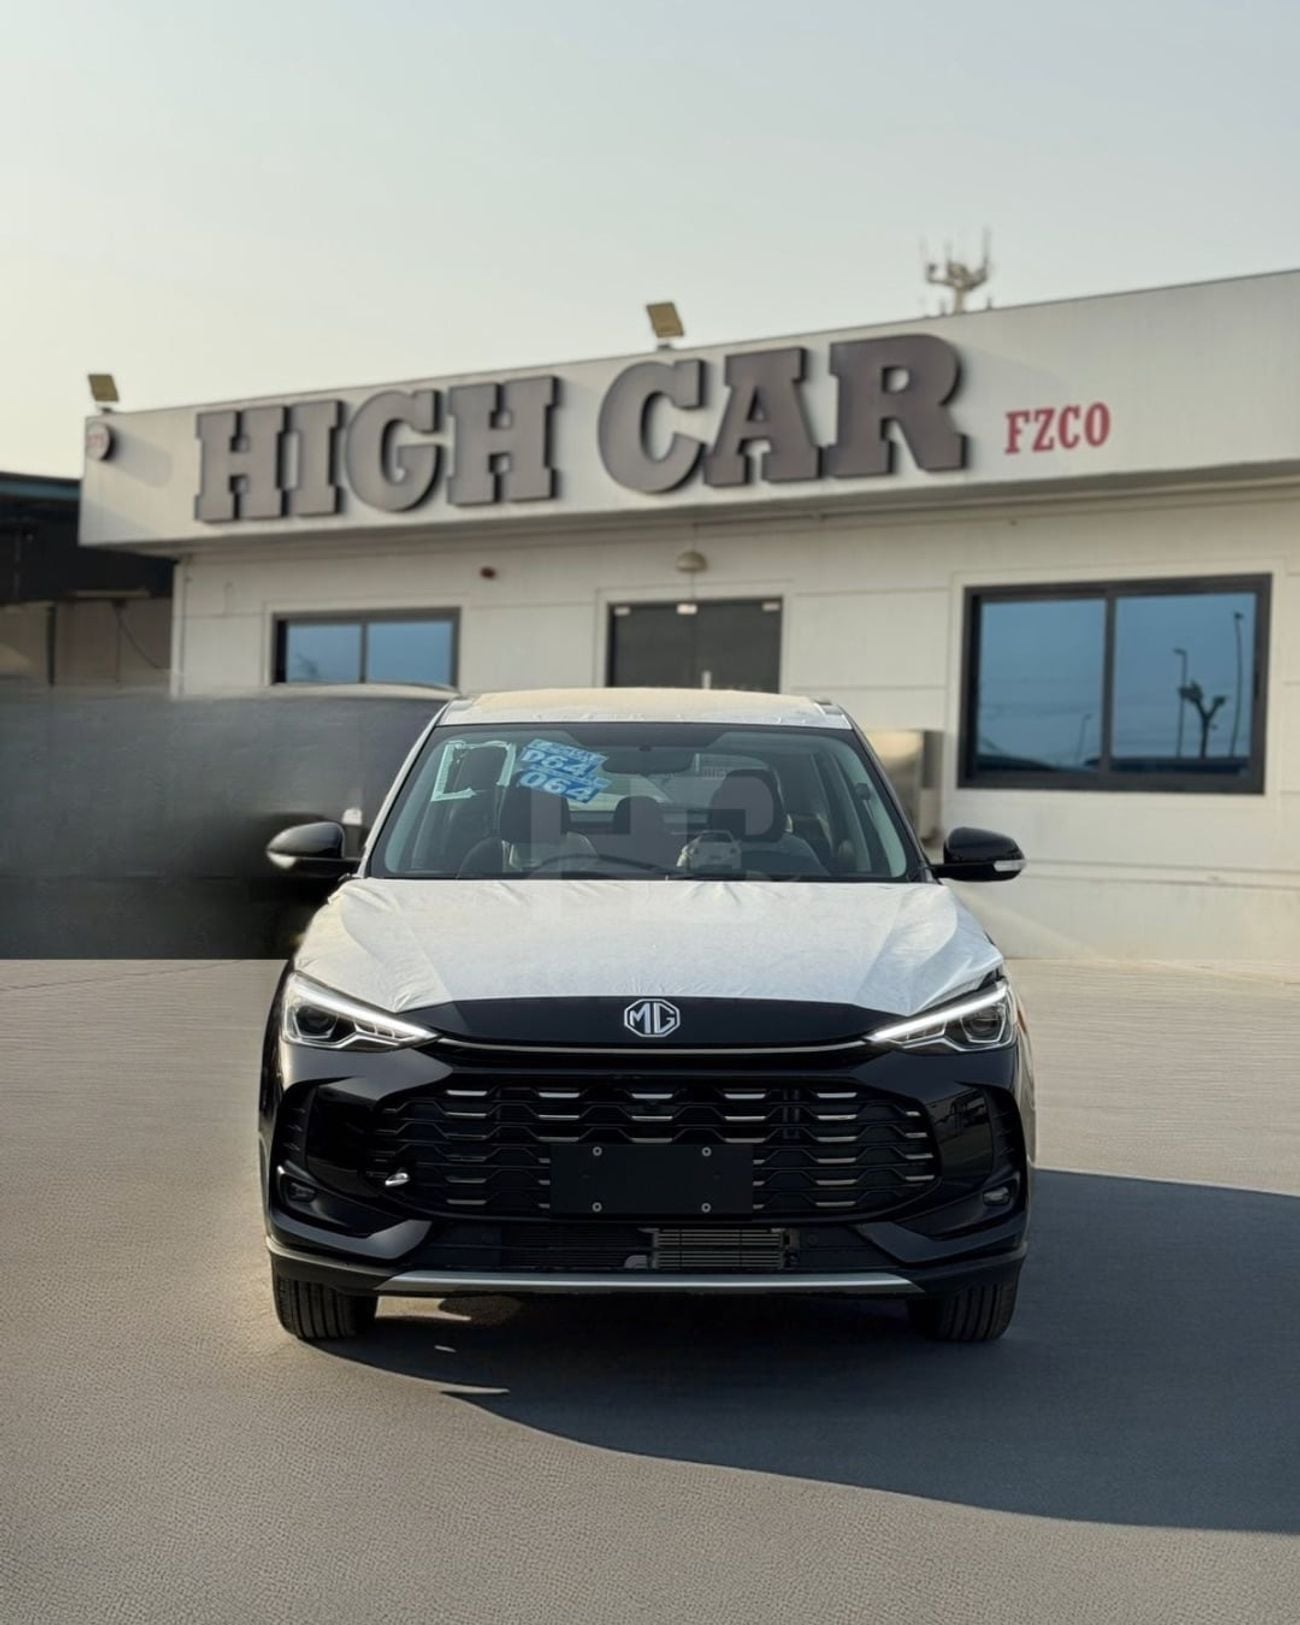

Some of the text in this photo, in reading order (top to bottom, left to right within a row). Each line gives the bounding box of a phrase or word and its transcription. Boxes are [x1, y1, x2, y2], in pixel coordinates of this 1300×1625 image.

[194, 333, 1111, 523] HIGH CAR FZCO
[629, 1002, 676, 1035] MG
